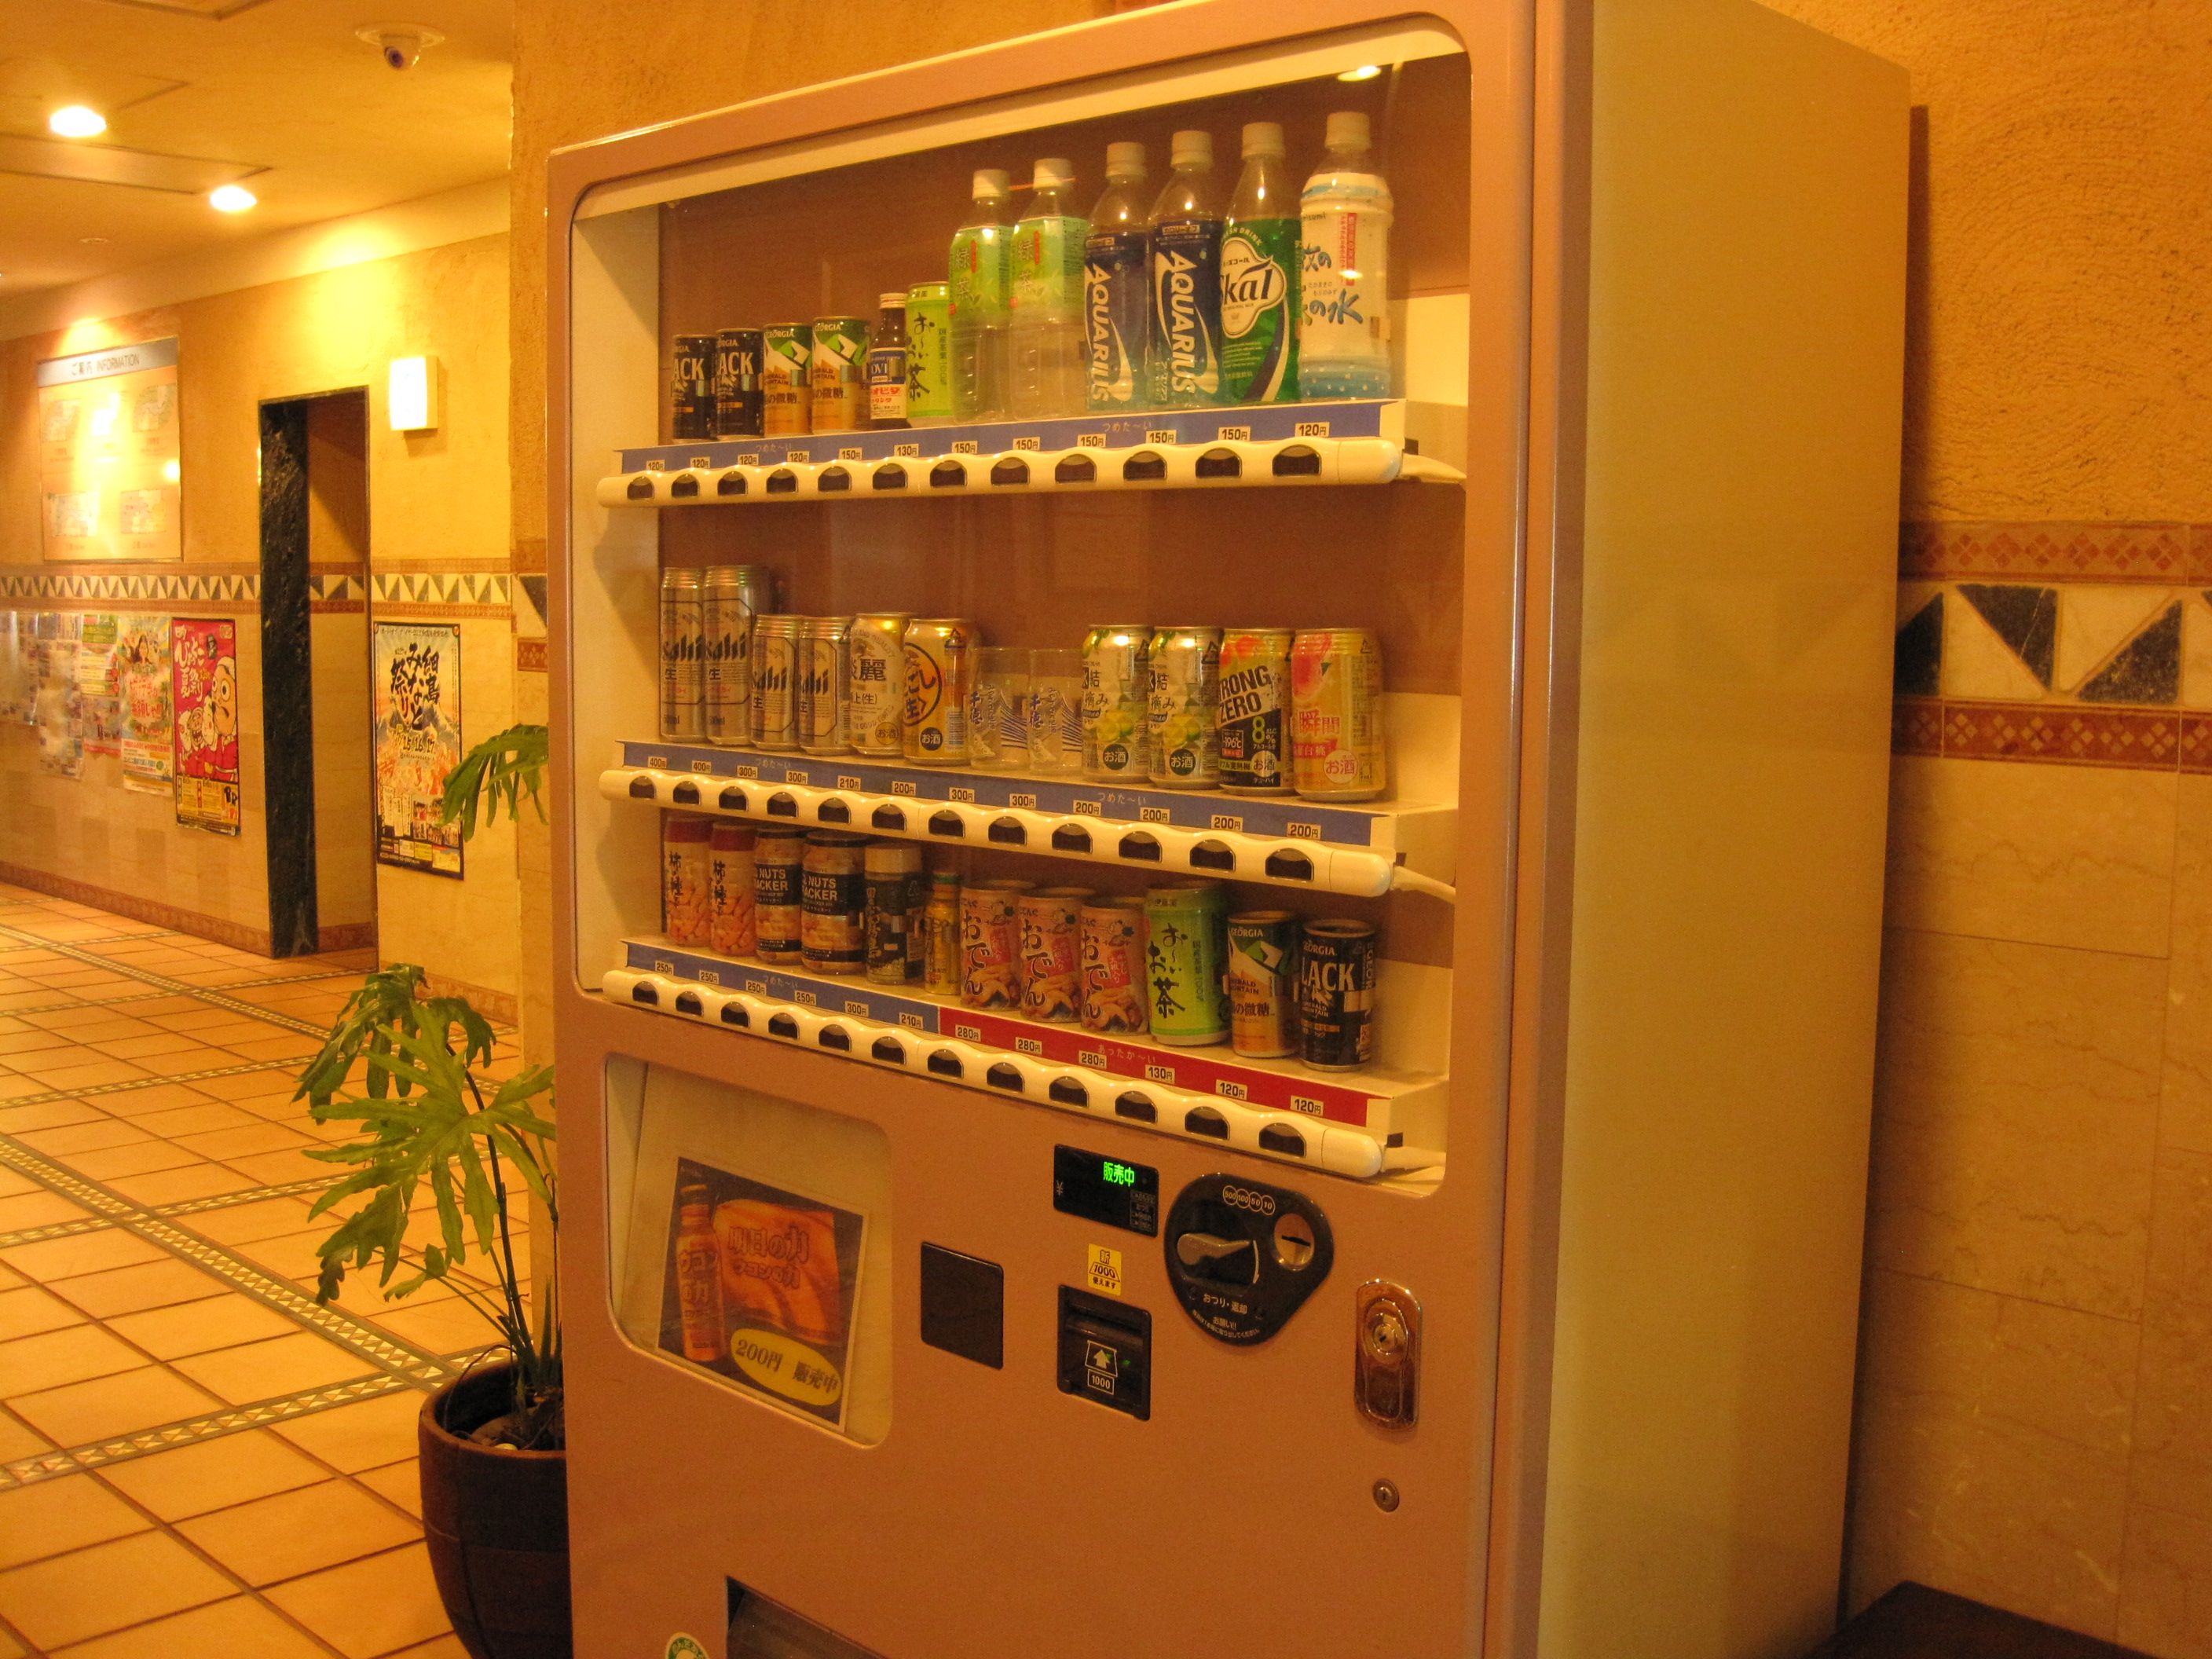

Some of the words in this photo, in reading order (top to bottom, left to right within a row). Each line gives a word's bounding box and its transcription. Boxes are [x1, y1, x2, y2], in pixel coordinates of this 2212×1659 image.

[1170, 250, 1198, 394] AQUARIUS
[1092, 262, 1111, 402] AQUARIUS
[71, 361, 93, 376] ご案内
[96, 353, 140, 373] INFORMATION
[1221, 428, 1247, 441] 150円
[1298, 424, 1327, 437] 120円
[1080, 435, 1104, 447] 150円
[1149, 431, 1174, 444] 150円
[896, 445, 917, 456] 130円
[954, 443, 976, 454] 150円
[1016, 439, 1038, 451] 150円
[739, 455, 757, 465] 120円
[789, 452, 808, 463] 120円
[841, 449, 861, 460] 150円
[647, 461, 664, 471] 120円
[692, 458, 709, 468] 120円
[709, 668, 721, 680] 生
[1221, 691, 1262, 724] ZERO
[877, 729, 897, 740] お酒
[1251, 716, 1266, 744] 8
[921, 733, 941, 745] お酒
[650, 757, 666, 769] 400円
[1104, 750, 1126, 764] お酒
[1170, 756, 1193, 769] お酒
[693, 761, 711, 773] 400円
[1253, 759, 1276, 771] お酒
[1325, 760, 1356, 775] お酒
[738, 767, 756, 778] 300円
[788, 772, 808, 784] 300円
[840, 778, 860, 790] 210円
[894, 783, 915, 795] 200円
[951, 789, 973, 802] 300円
[1012, 795, 1035, 808] 300円
[1075, 801, 1100, 815] 200円
[1143, 809, 1168, 822] 200円
[1214, 816, 1241, 830] 200円
[1290, 824, 1319, 838] 200円
[759, 868, 786, 879] NUTS
[808, 875, 837, 889] NUTS
[964, 910, 990, 996] おでん
[656, 961, 673, 973] 250円
[1022, 918, 1053, 1008] おでん
[700, 971, 719, 983] 250円
[1082, 928, 1109, 1020] おでん
[747, 981, 766, 994] 250円
[796, 991, 815, 1005] 250円
[846, 1002, 867, 1015] 300円
[901, 1014, 922, 1028] 210円
[957, 1026, 979, 1040] 280円
[1017, 1039, 1041, 1053] 280円
[1081, 1052, 1104, 1067] 280円
[1148, 1066, 1173, 1082] 130円
[1219, 1082, 1245, 1097] 120円
[1295, 1098, 1321, 1114] 120円
[1103, 1161, 1135, 1187] 販売中
[1238, 1195, 1249, 1203] 100
[1251, 1198, 1261, 1207] 50
[1264, 1201, 1273, 1210] 10
[728, 1224, 810, 1265] 明日の力
[1100, 1249, 1111, 1265] 新
[1093, 1264, 1116, 1279] 1000
[1203, 1293, 1247, 1315] おつり・返却
[735, 1339, 783, 1373] 200円
[793, 1361, 838, 1393] 販売中
[1092, 1375, 1111, 1390] 1000
